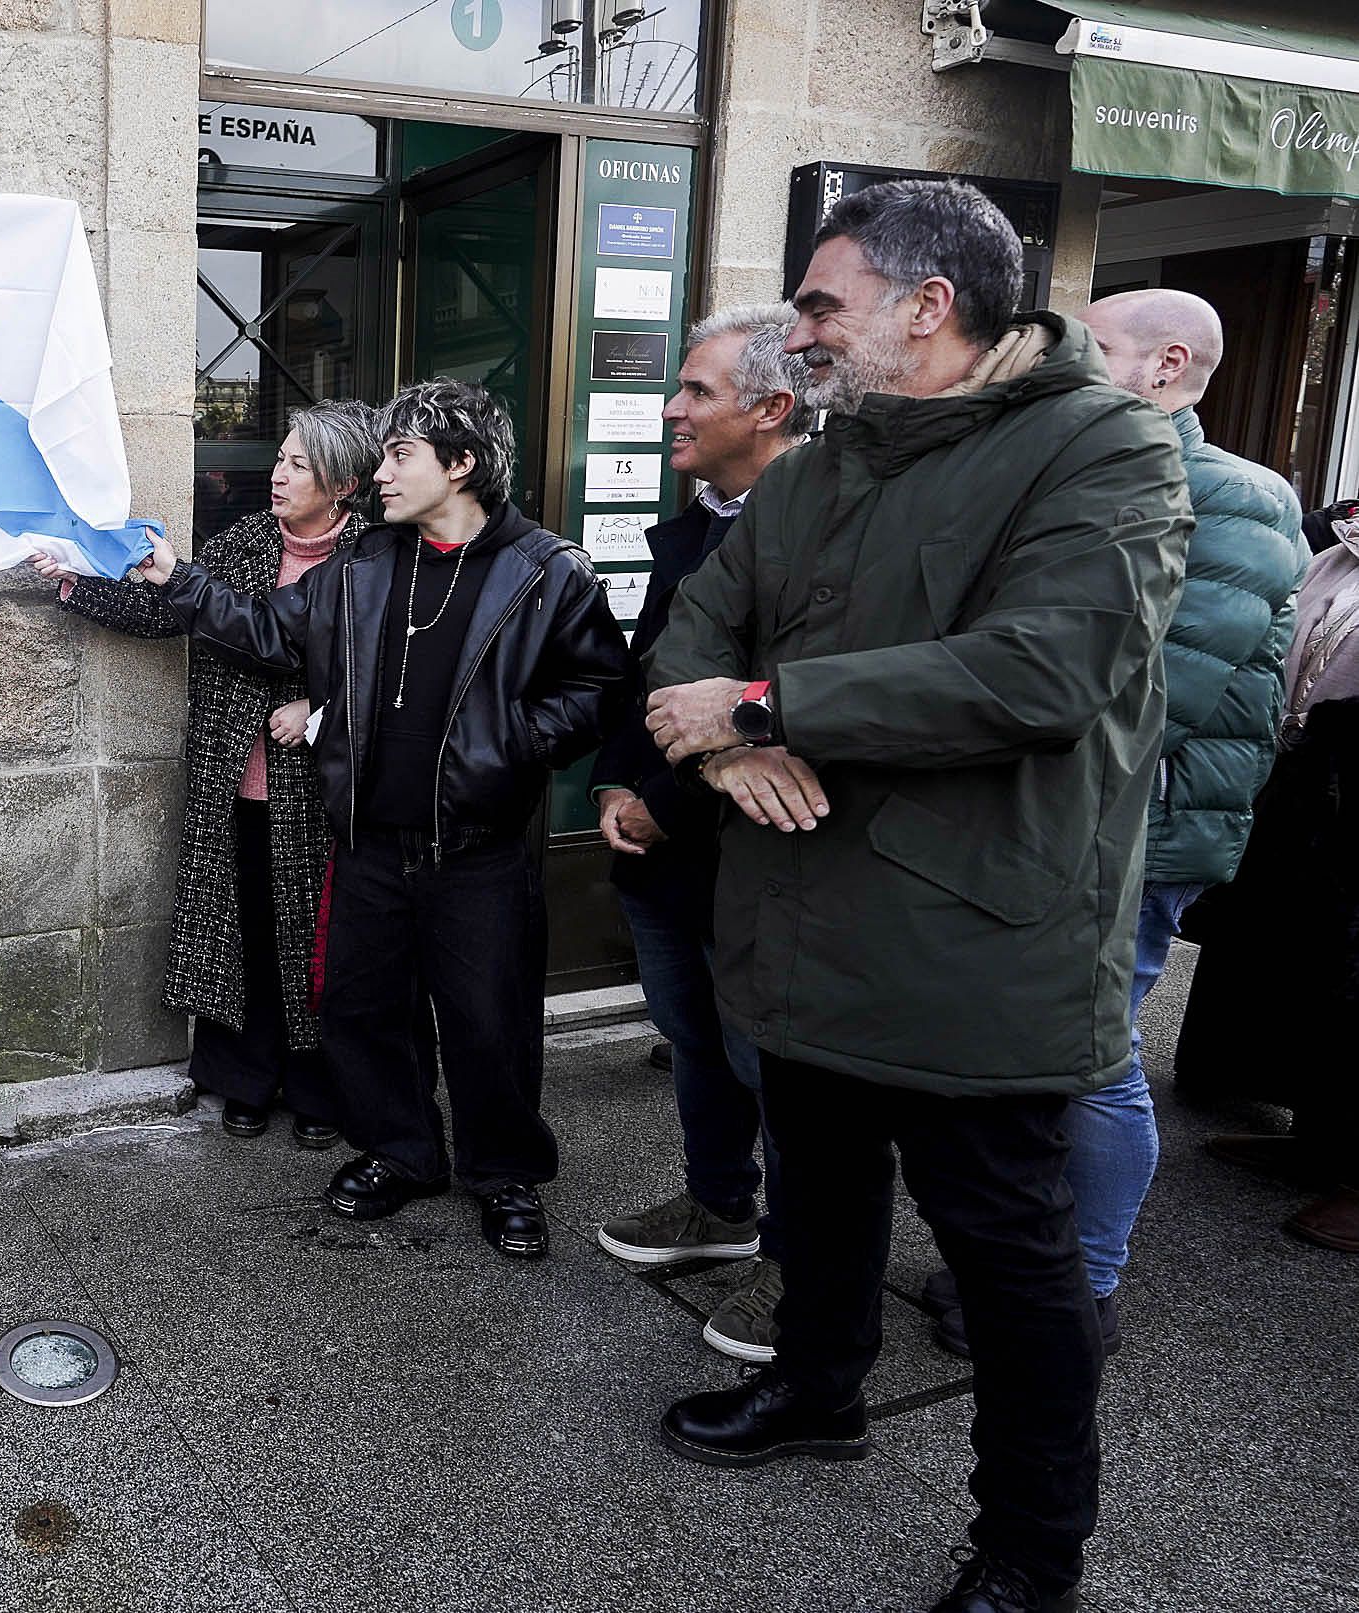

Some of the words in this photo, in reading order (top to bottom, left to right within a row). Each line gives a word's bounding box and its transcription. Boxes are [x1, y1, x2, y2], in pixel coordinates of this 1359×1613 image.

[464, 0, 483, 38] 1
[221, 116, 317, 146] ESPAÑA
[1095, 105, 1198, 134] souvenirs
[599, 159, 681, 184] OFICINAS
[615, 460, 634, 474] T.S.
[595, 532, 645, 544] KURINUKI
